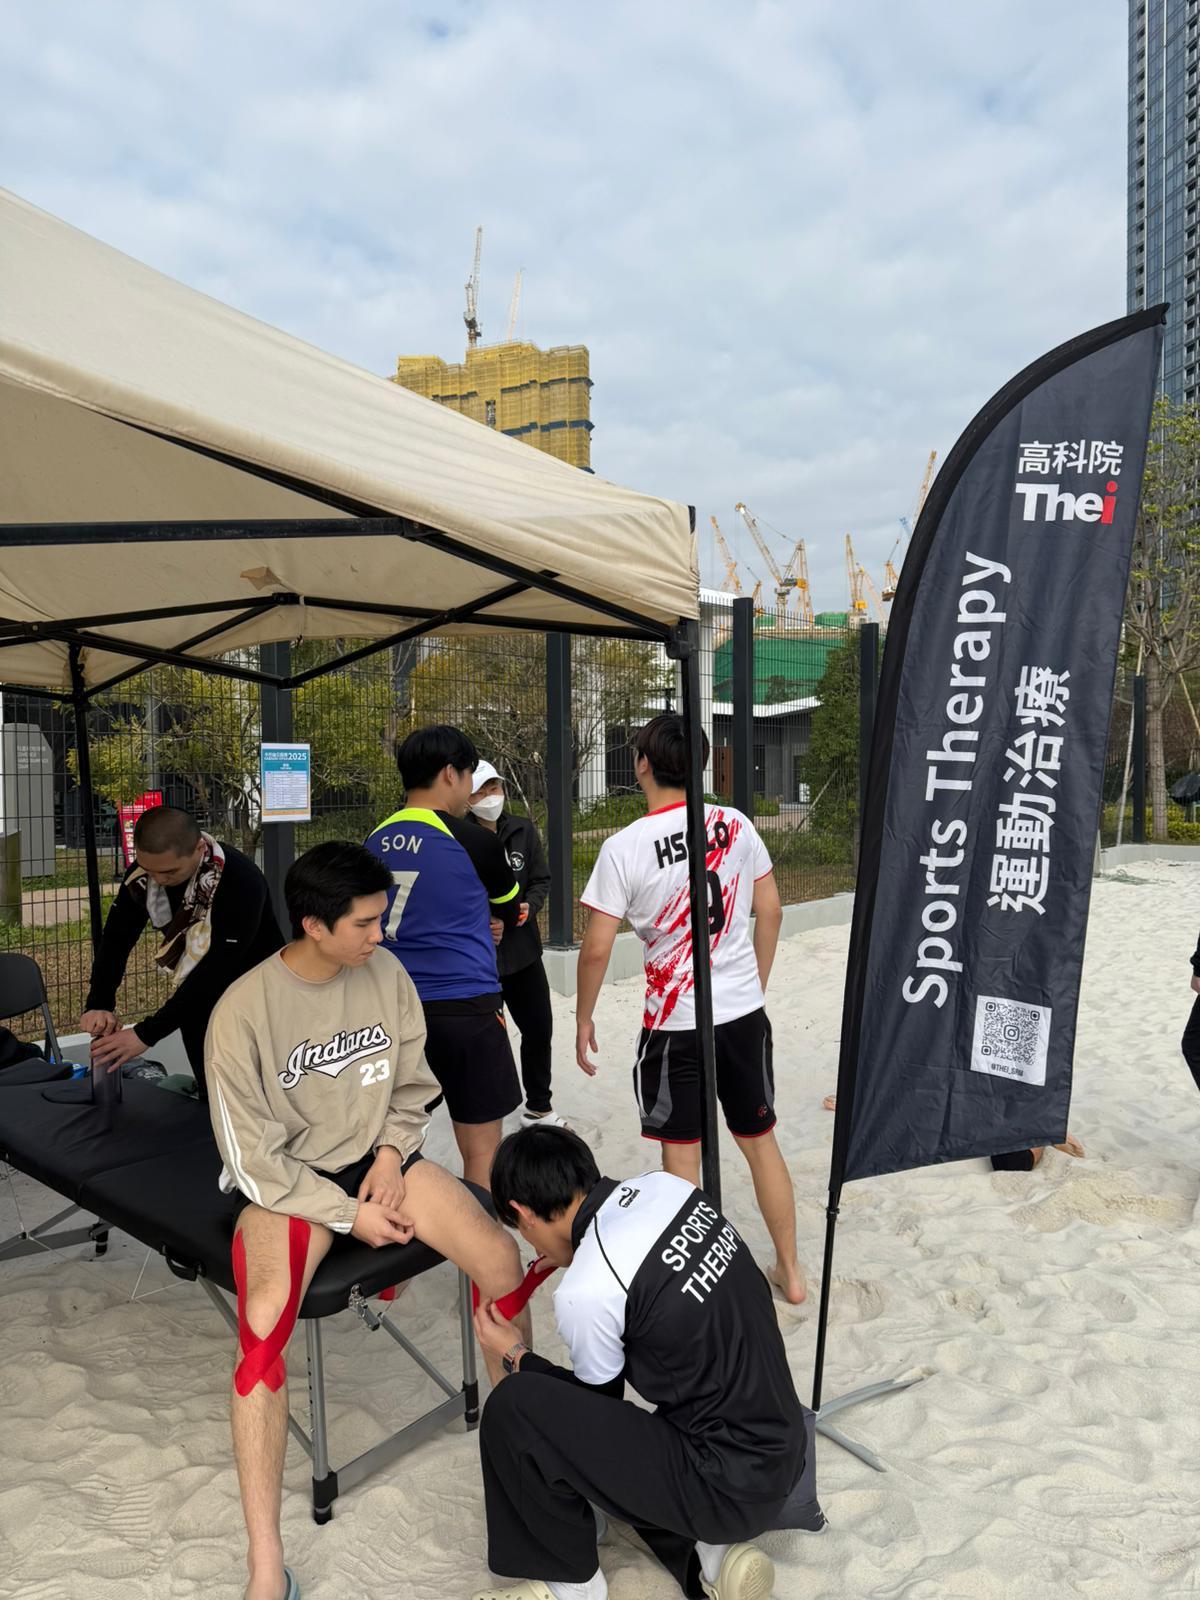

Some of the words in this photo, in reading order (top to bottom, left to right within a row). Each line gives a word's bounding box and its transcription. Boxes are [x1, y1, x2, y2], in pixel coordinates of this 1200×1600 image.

[1018, 439, 1124, 476] 高科院
[1015, 480, 1118, 526] Thei
[925, 551, 1013, 802] Therapy
[288, 752, 307, 760] 2025
[986, 665, 1071, 916] 運動治療
[381, 834, 423, 854] SON
[384, 871, 420, 941] 7
[902, 818, 969, 1009] Sports
[278, 1022, 392, 1091] Indians
[359, 1059, 390, 1087] 23
[661, 1201, 719, 1272] SPORTS
